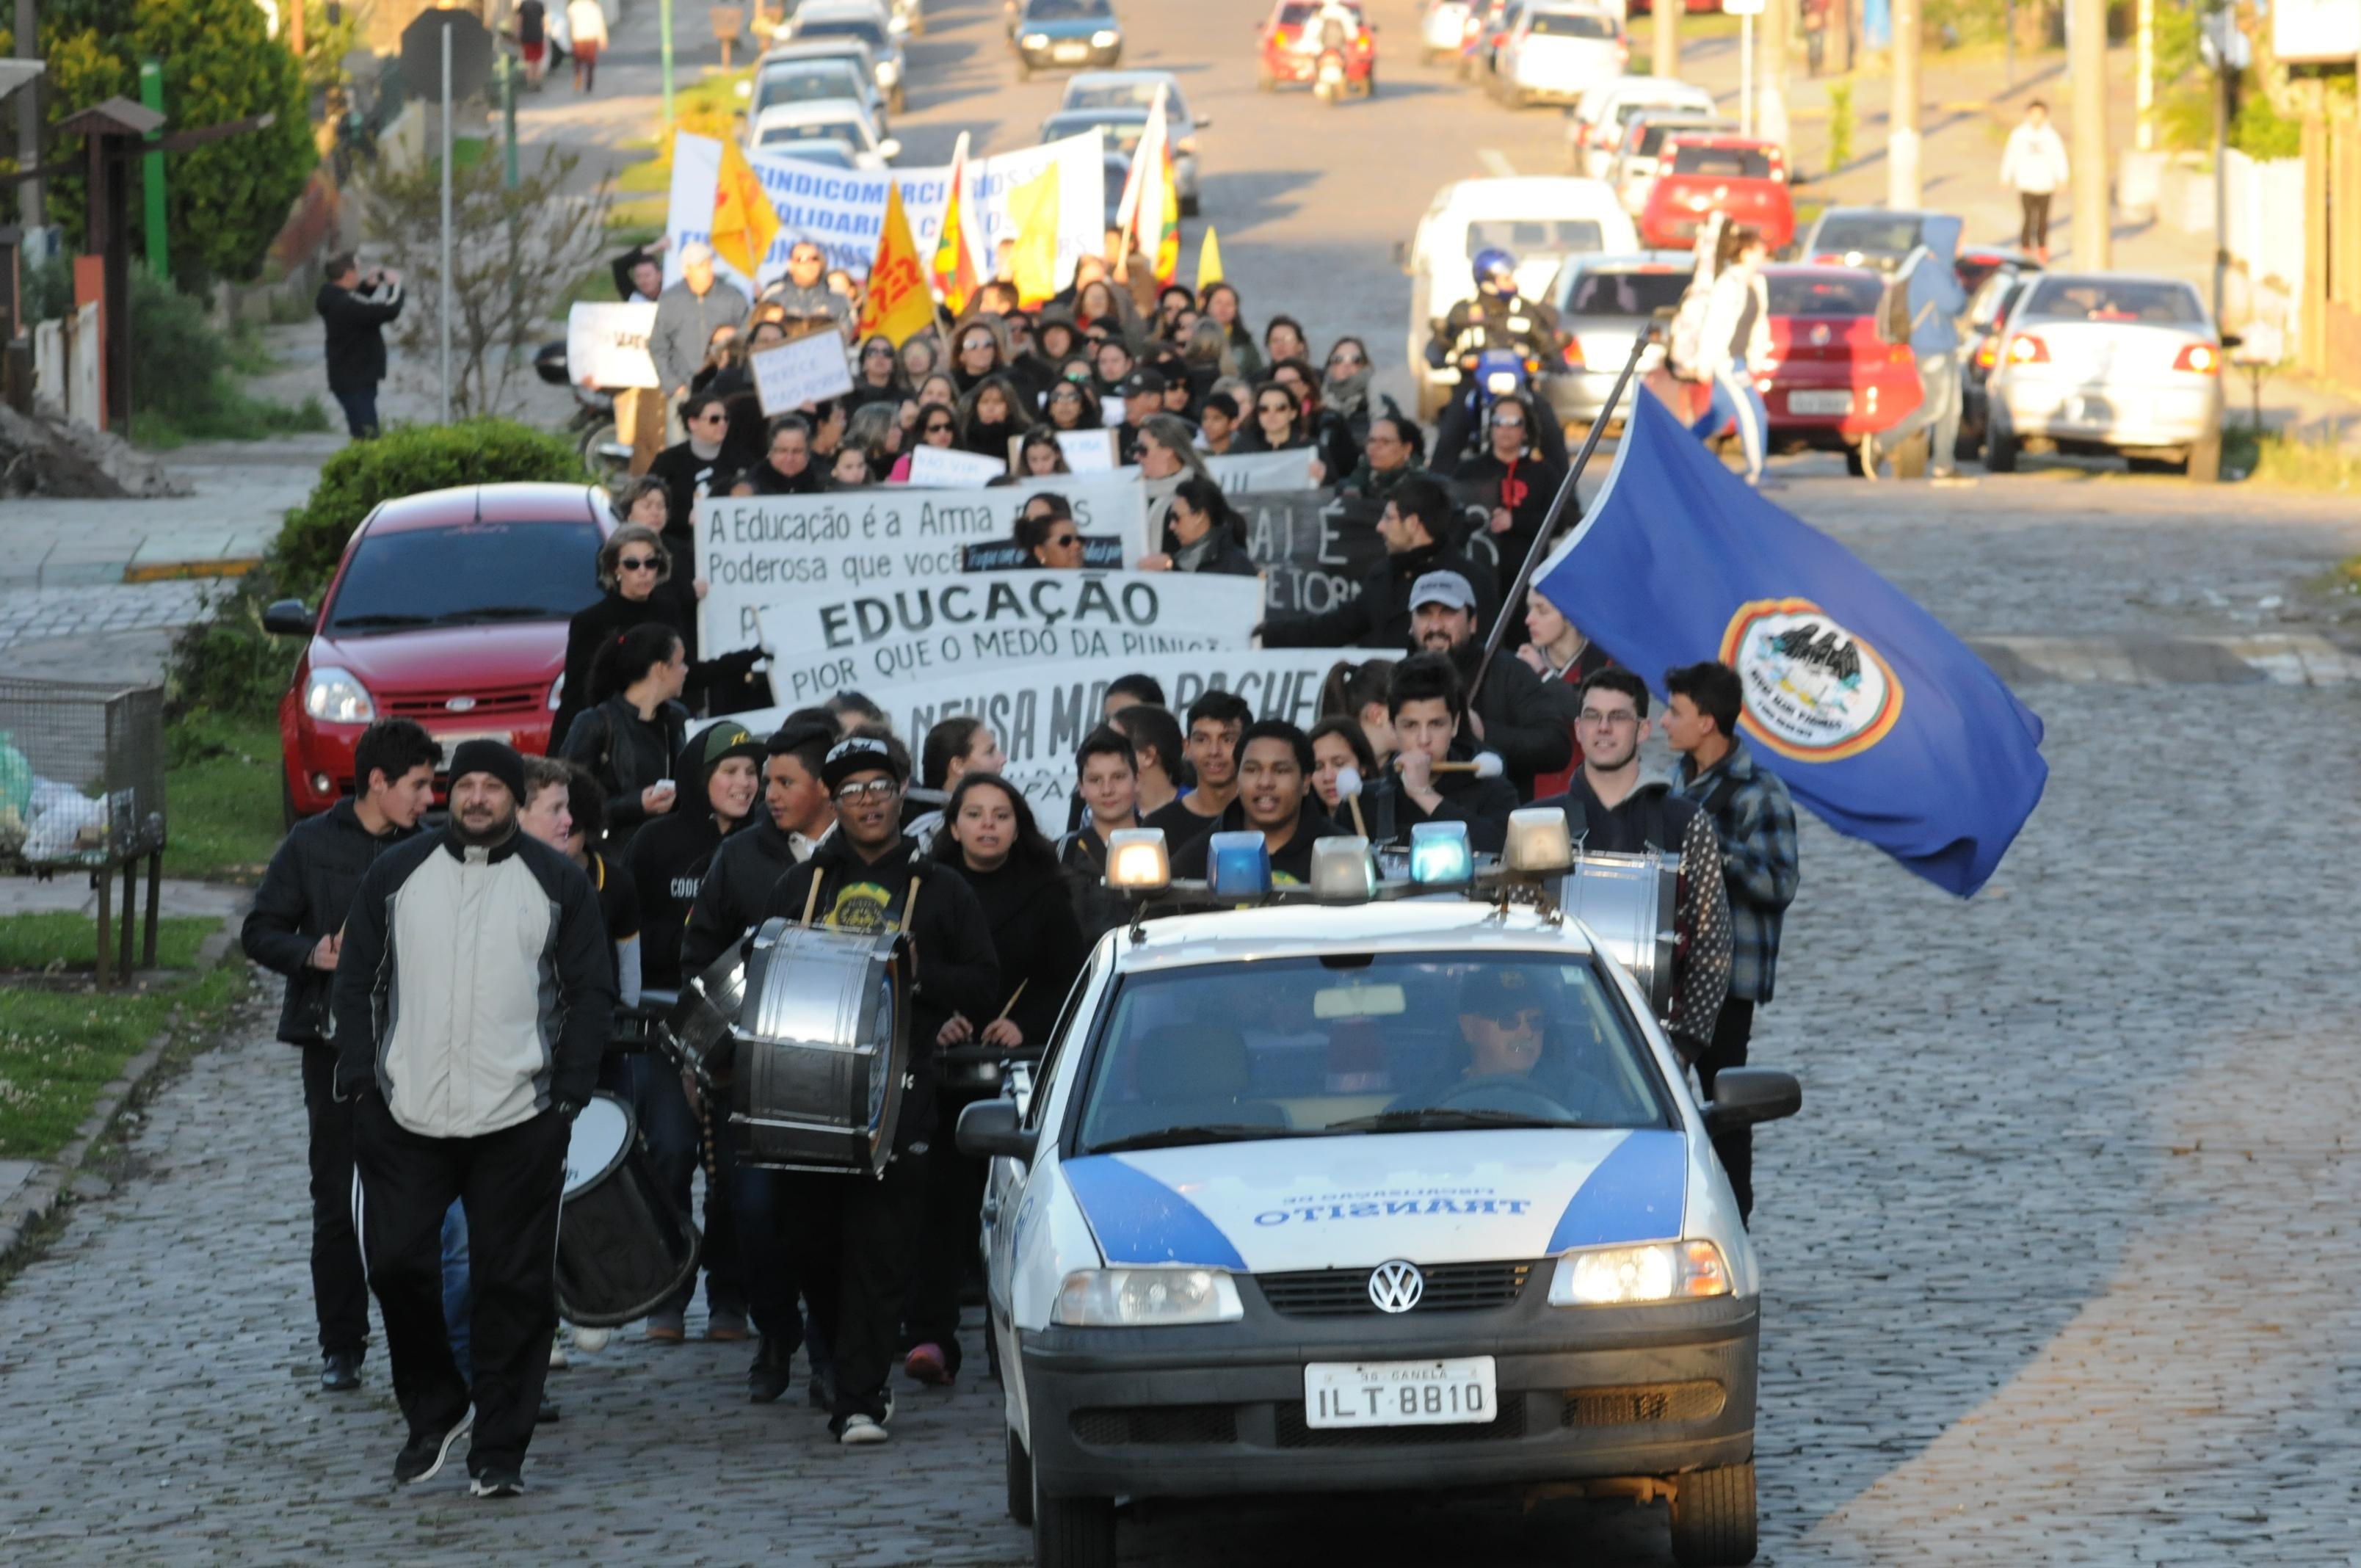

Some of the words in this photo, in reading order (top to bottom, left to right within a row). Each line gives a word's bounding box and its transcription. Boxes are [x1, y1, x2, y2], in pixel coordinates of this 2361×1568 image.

[709, 510, 725, 544] A
[735, 506, 850, 545] Educação
[863, 504, 876, 538] é
[885, 511, 900, 536] a
[919, 501, 992, 536] Arma
[709, 552, 827, 585] Poderosa
[841, 553, 891, 587] que
[819, 572, 1158, 650] EDUCAÇÃO
[791, 657, 857, 700] PIOR
[874, 639, 932, 678] QUE
[940, 635, 960, 661] O
[973, 628, 1058, 658] MEDO
[1072, 628, 1109, 657] DA
